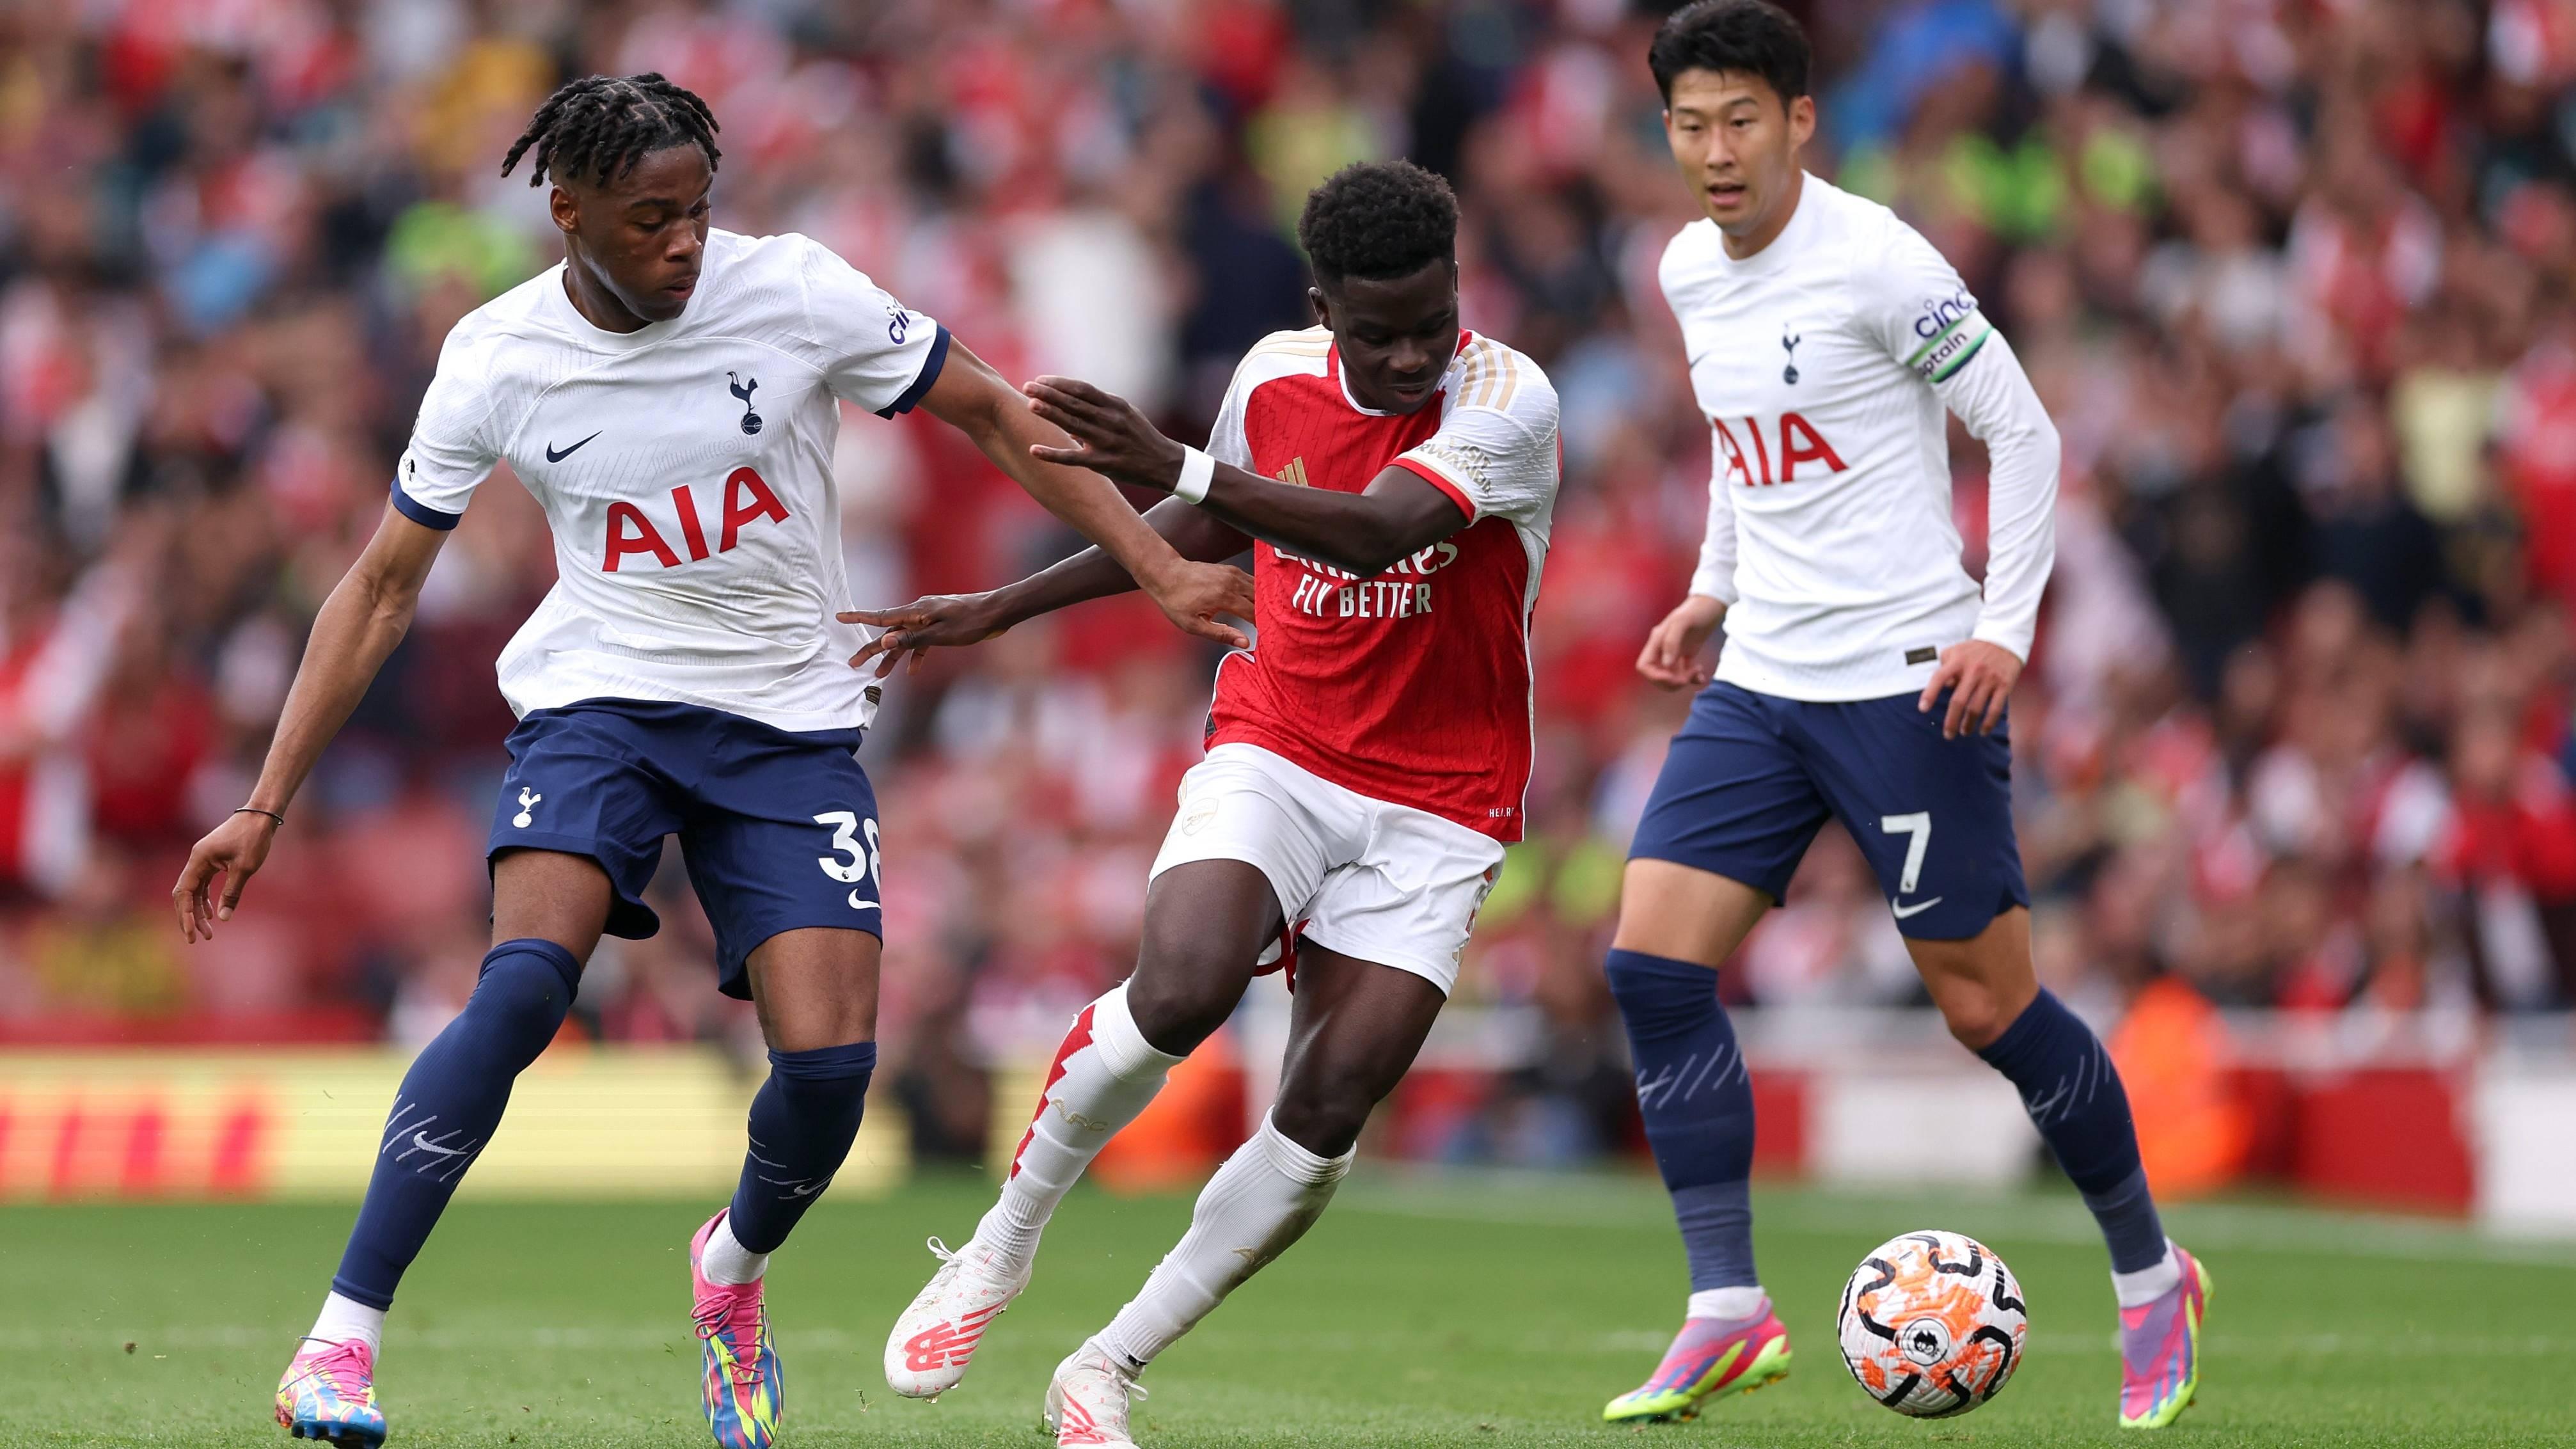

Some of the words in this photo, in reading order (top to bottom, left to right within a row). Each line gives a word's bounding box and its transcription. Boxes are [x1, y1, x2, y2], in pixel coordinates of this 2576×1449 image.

[1921, 332, 1968, 376] ptain
[1714, 411, 1849, 487] AIA
[601, 466, 790, 573] AIA
[1292, 573, 1333, 617] FLY
[1339, 580, 1433, 619] BETTER
[812, 811, 881, 894] 38
[1881, 811, 1932, 893] 7
